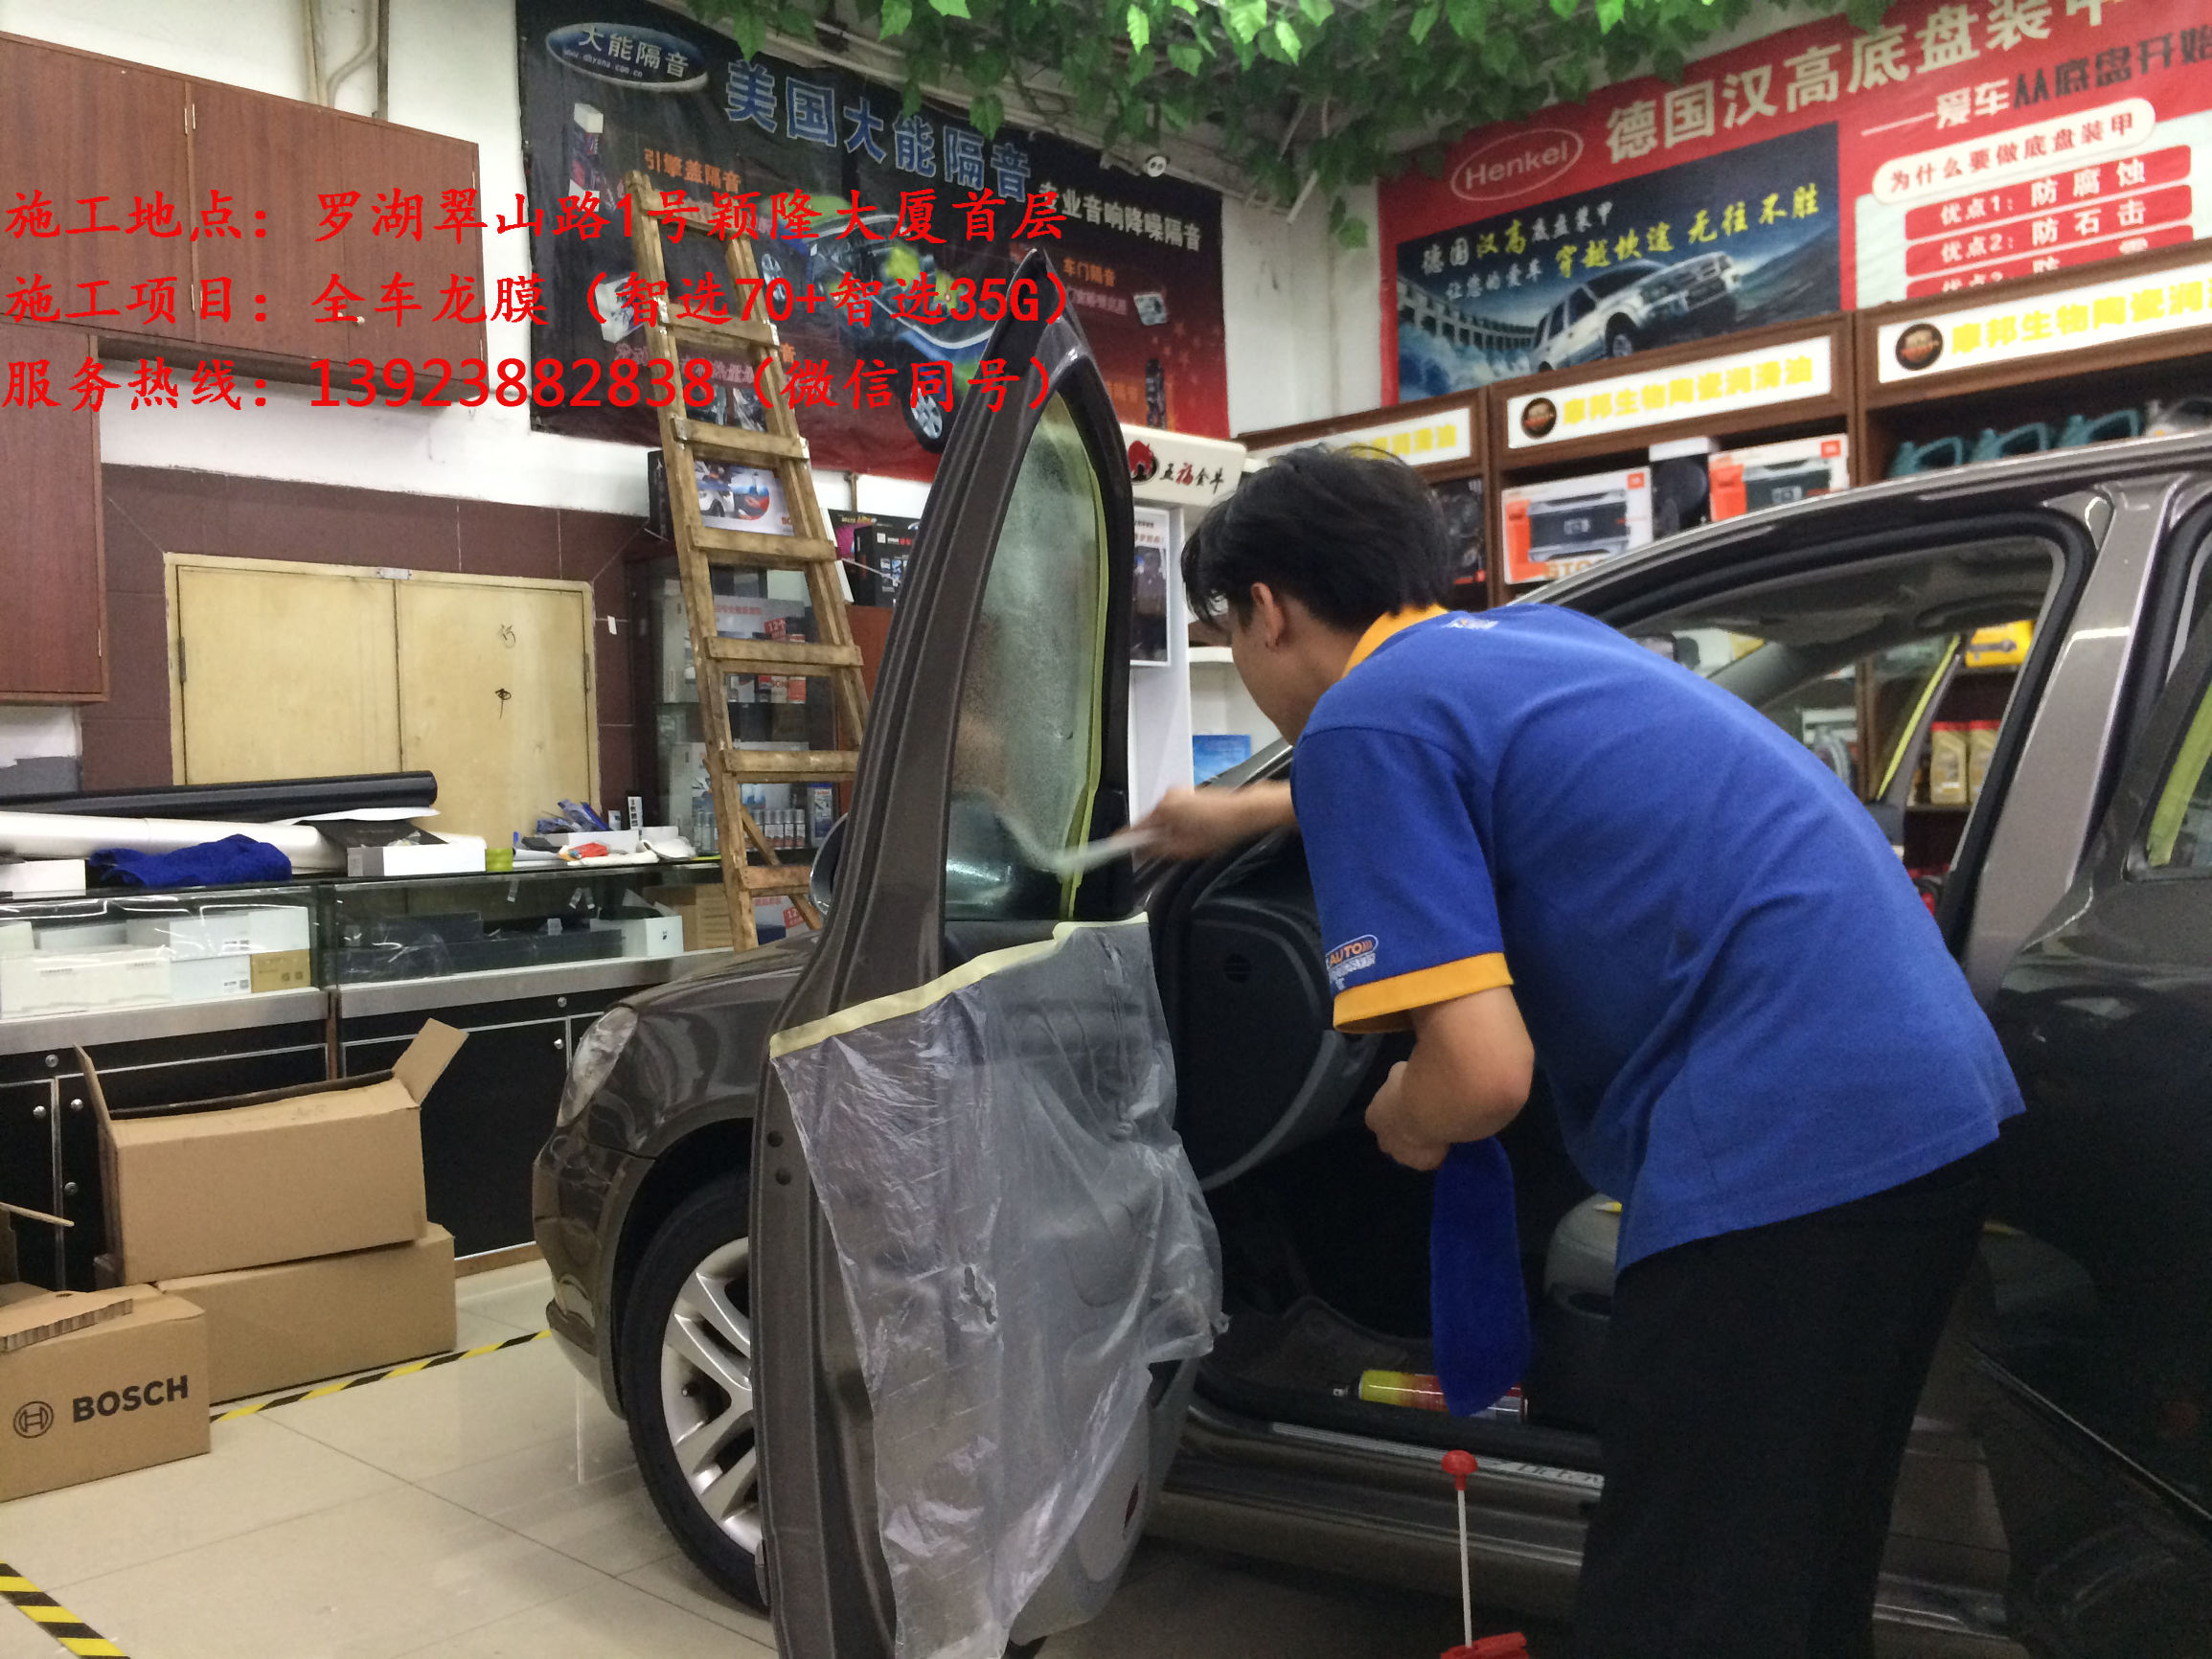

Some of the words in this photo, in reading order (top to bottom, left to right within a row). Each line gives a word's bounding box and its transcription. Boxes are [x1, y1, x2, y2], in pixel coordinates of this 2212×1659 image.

[578, 25, 689, 78] 大能隔音
[1606, 0, 2124, 164] 德国汉高底盘装
[724, 58, 1032, 204] 美国大能隔音
[1890, 111, 2134, 193] 为什么要做底盘装甲
[1465, 140, 1568, 191] Henkel
[2030, 158, 2147, 208] 防腐蚀
[2030, 198, 2147, 248] 防石击
[72, 1375, 190, 1424] BOSCH
